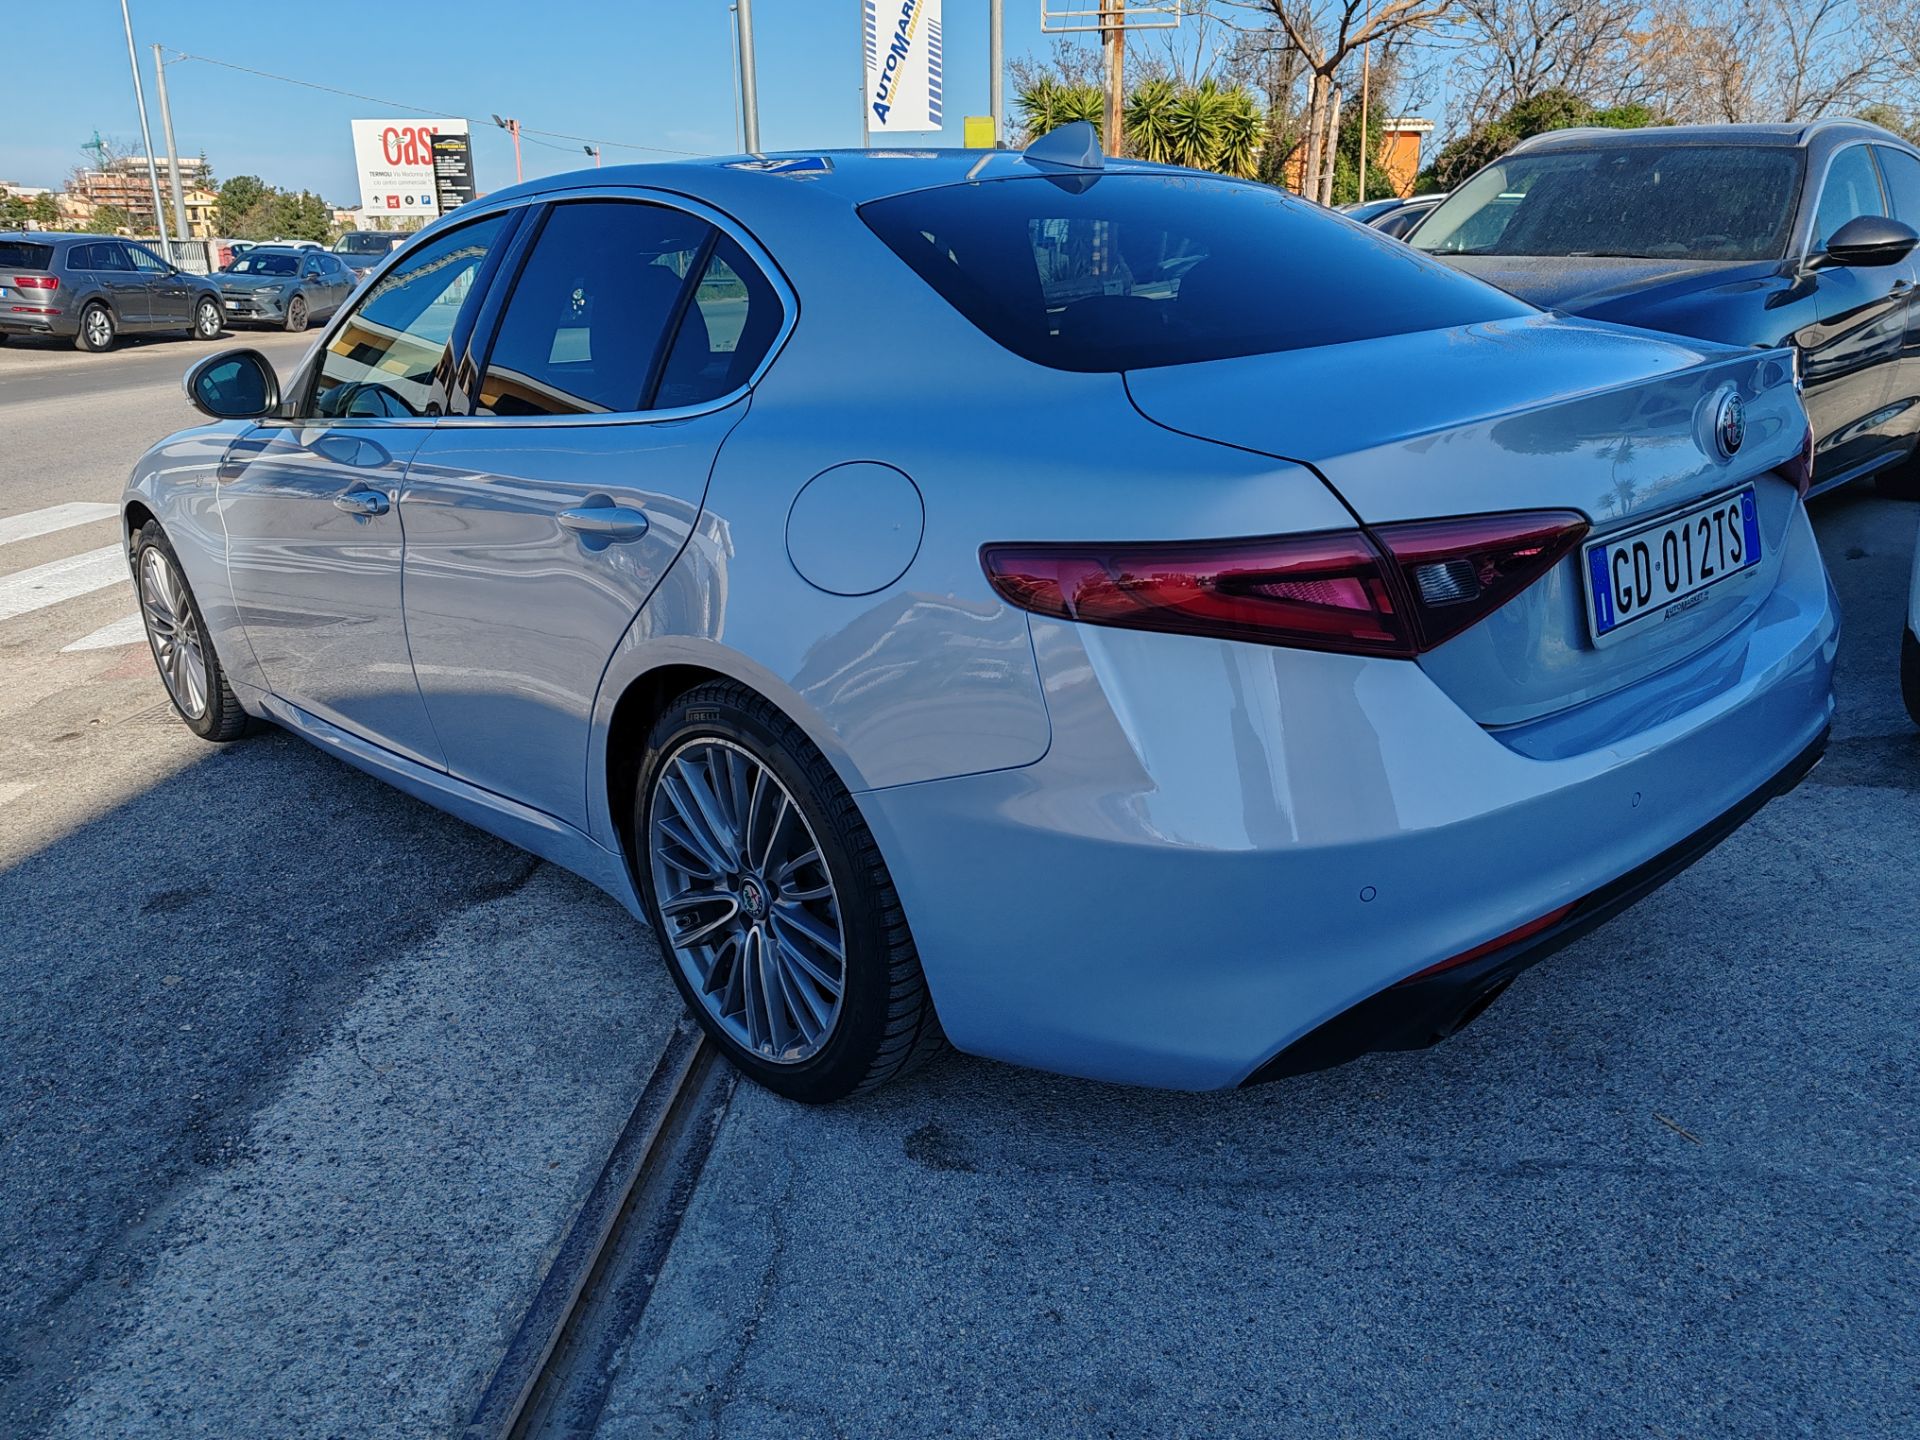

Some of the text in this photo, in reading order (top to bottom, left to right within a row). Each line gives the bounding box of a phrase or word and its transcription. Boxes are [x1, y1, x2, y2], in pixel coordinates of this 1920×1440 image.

[1612, 504, 1743, 614] GD 012TS
[686, 707, 720, 722] PIRELLI
